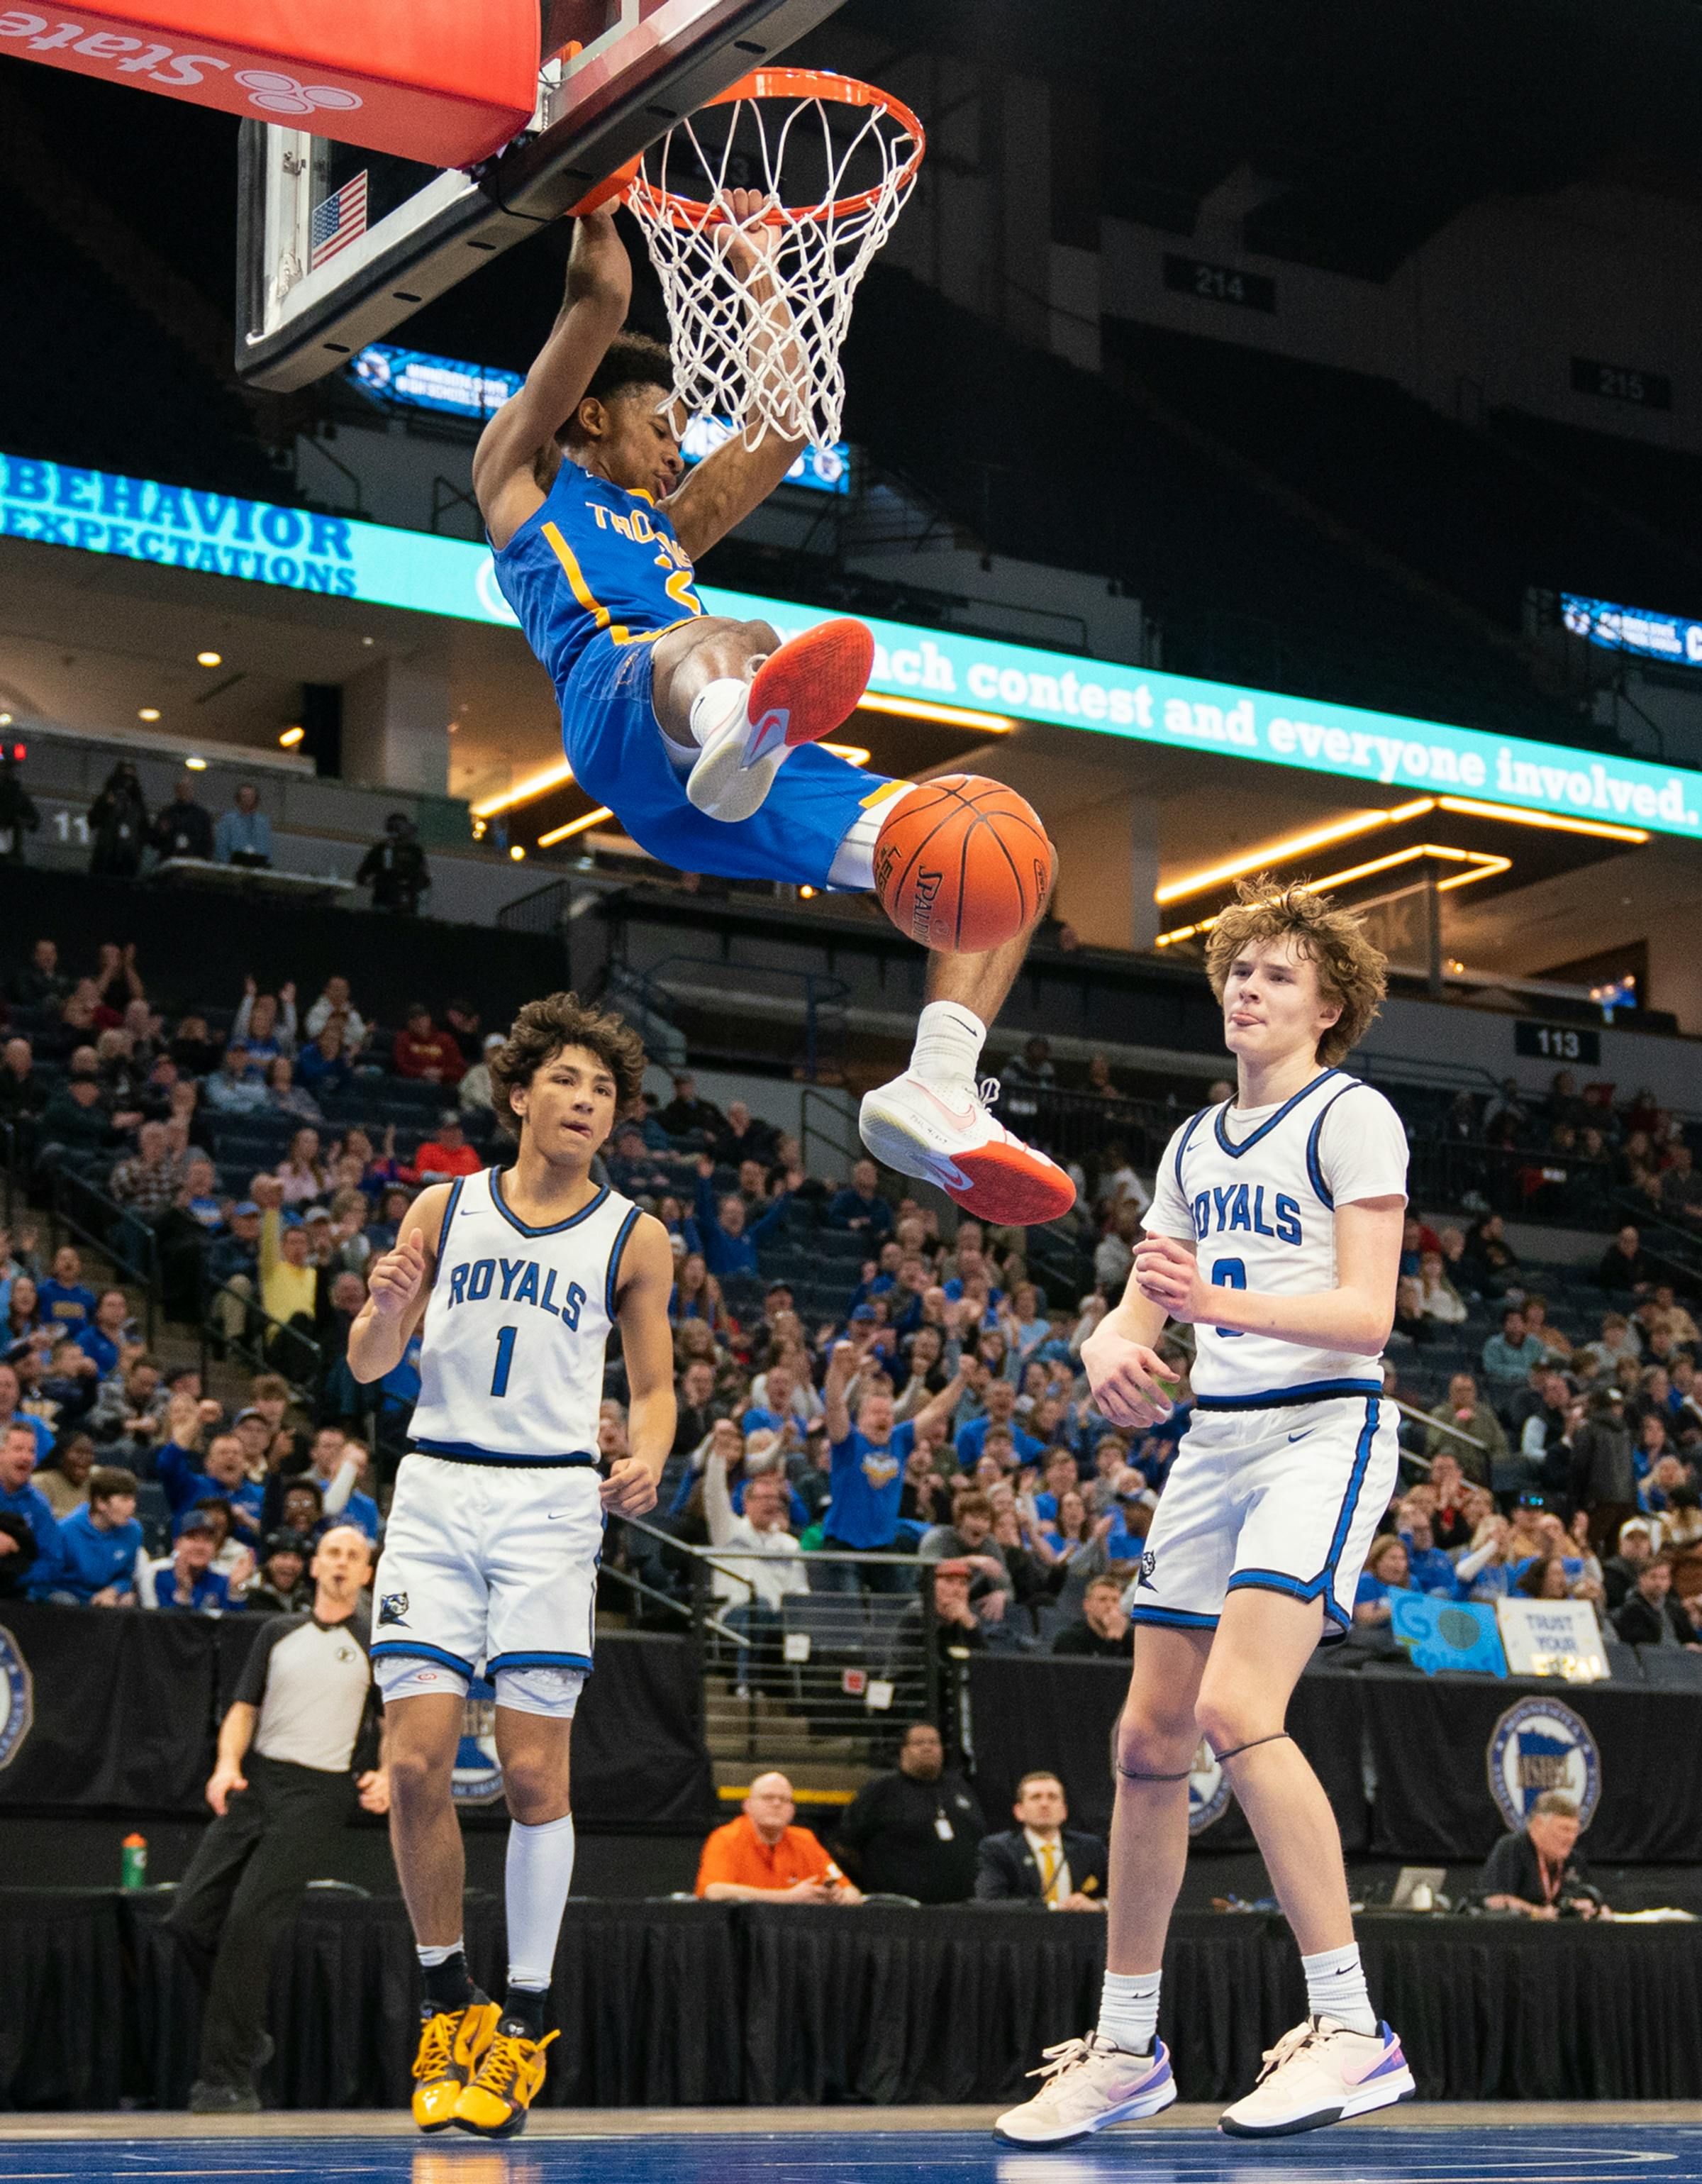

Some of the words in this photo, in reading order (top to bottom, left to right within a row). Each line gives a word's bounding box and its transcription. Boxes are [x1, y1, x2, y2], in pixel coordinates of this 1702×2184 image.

[0, 11, 231, 86] State
[1196, 267, 1244, 300] 214
[1600, 370, 1645, 399] 215
[2, 454, 353, 560] BEHAVIOR
[1, 507, 357, 597] EXPECTATIONS
[967, 649, 1154, 728] contest
[1164, 698, 1257, 746] and
[1268, 718, 1485, 784] everyone
[1496, 747, 1699, 826] involved.
[1537, 1028, 1579, 1059] 113
[1189, 1183, 1303, 1246] OYALS
[447, 1258, 587, 1333] ROYALS
[490, 1325, 518, 1397] 1
